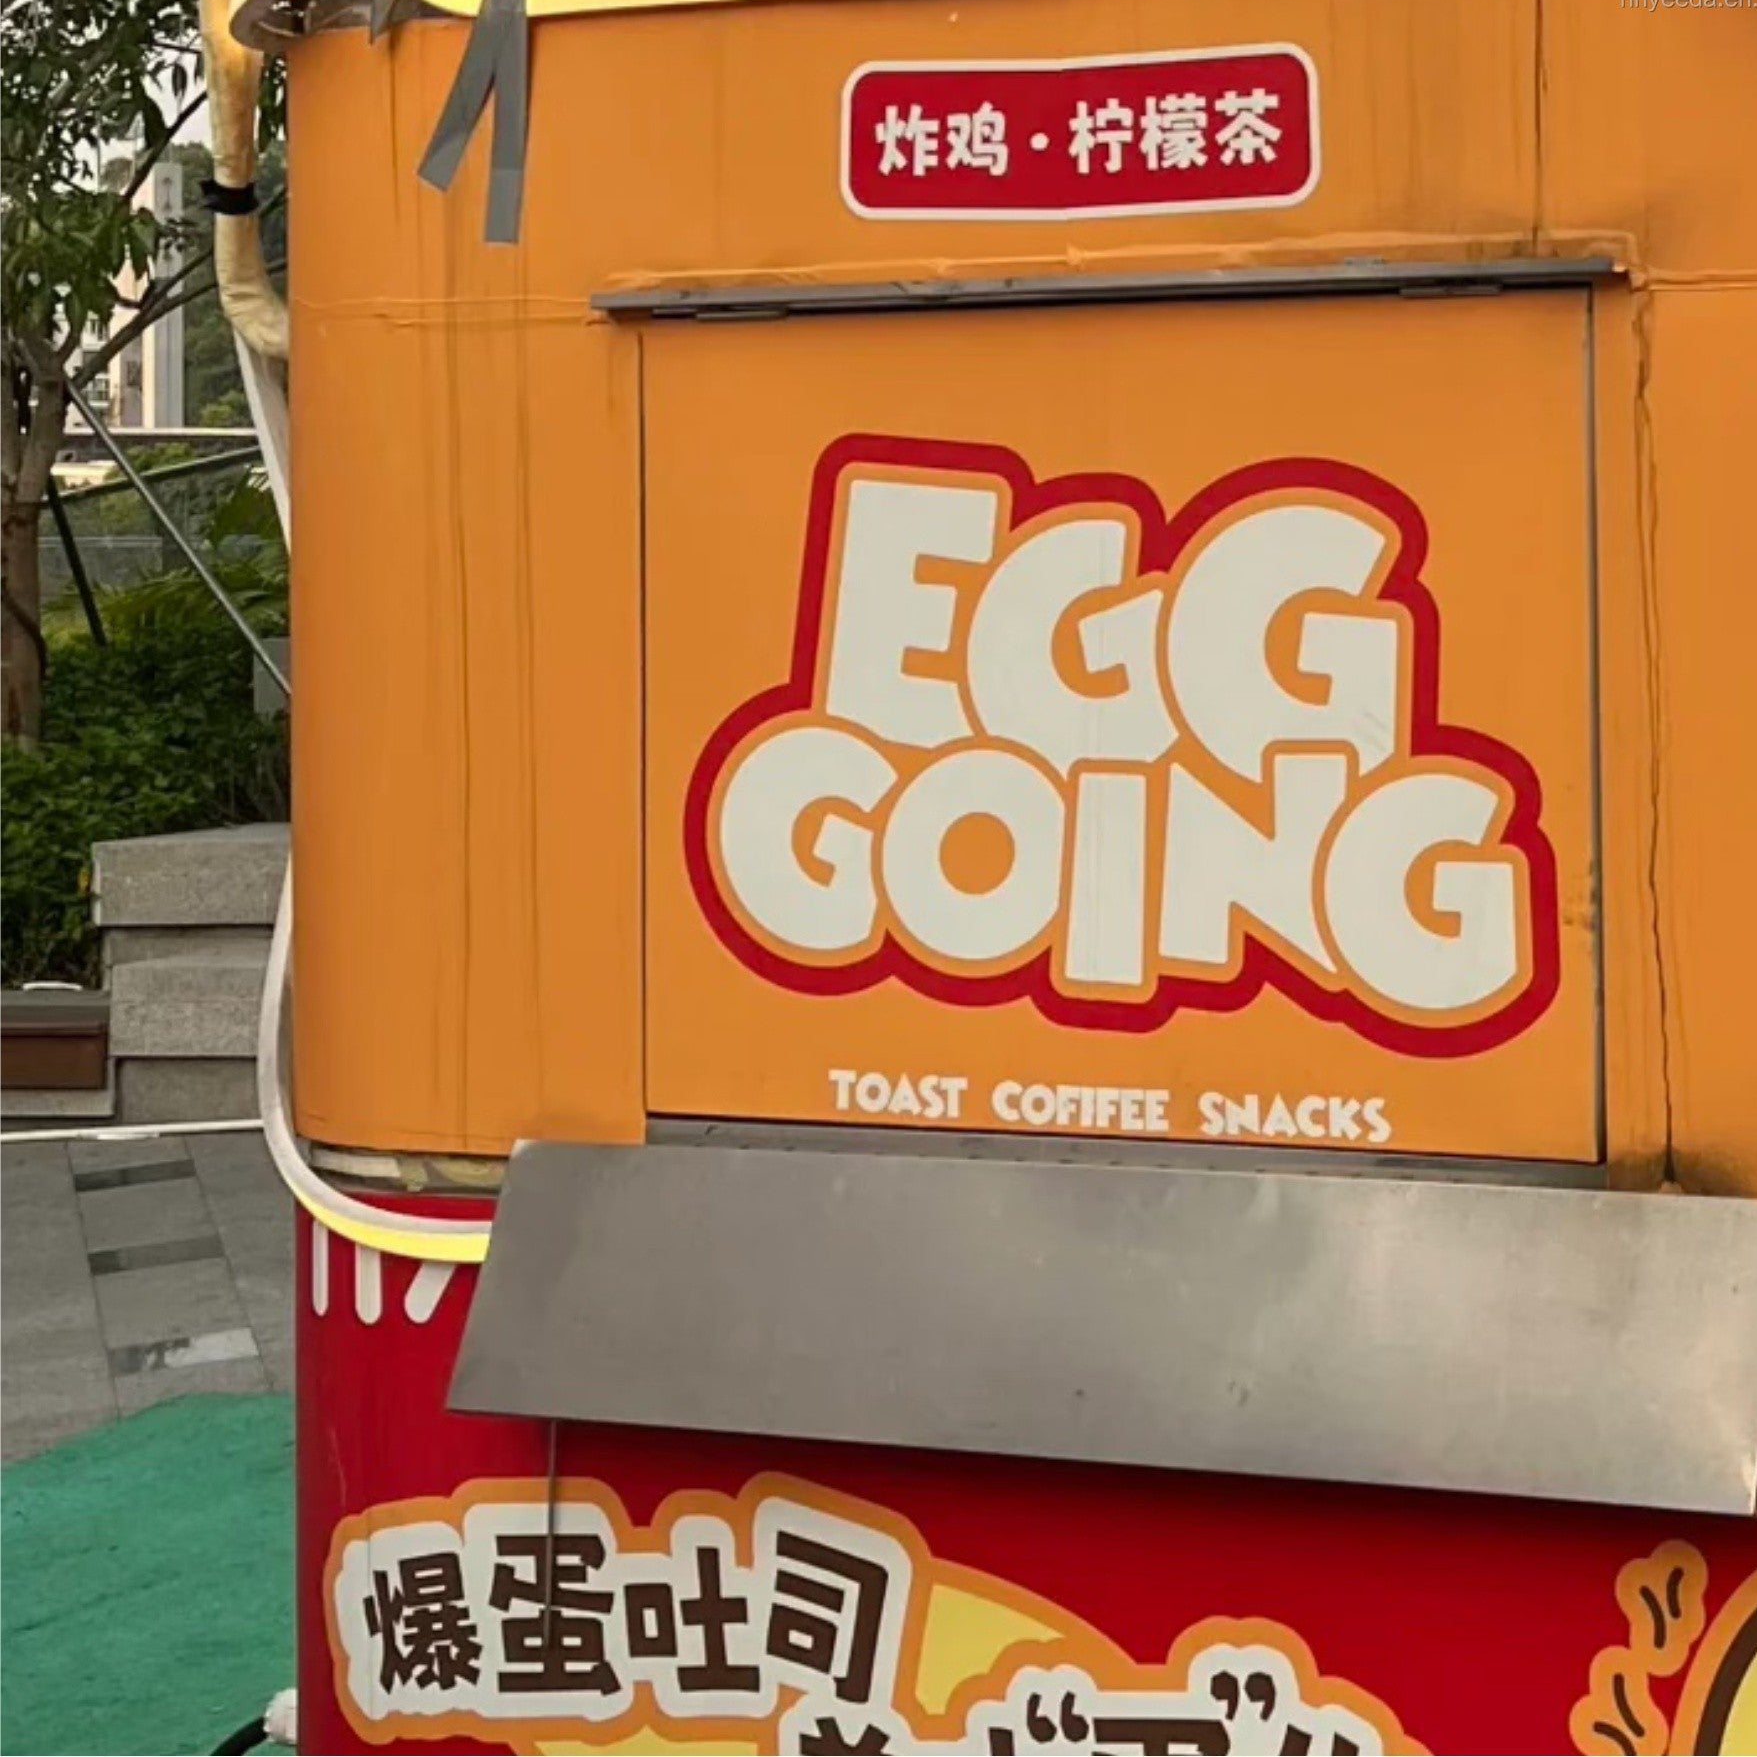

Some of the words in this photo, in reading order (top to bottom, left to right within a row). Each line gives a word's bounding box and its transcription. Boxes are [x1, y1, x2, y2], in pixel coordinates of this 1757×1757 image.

[874, 86, 1284, 177] 炸鸡·柠檬茶
[824, 478, 1400, 785] EGG
[716, 725, 1520, 1012] GOING
[828, 1068, 969, 1119] TOAST
[1199, 1091, 1393, 1144] SNACKS
[363, 1529, 892, 1704] 爆蛋吐司
